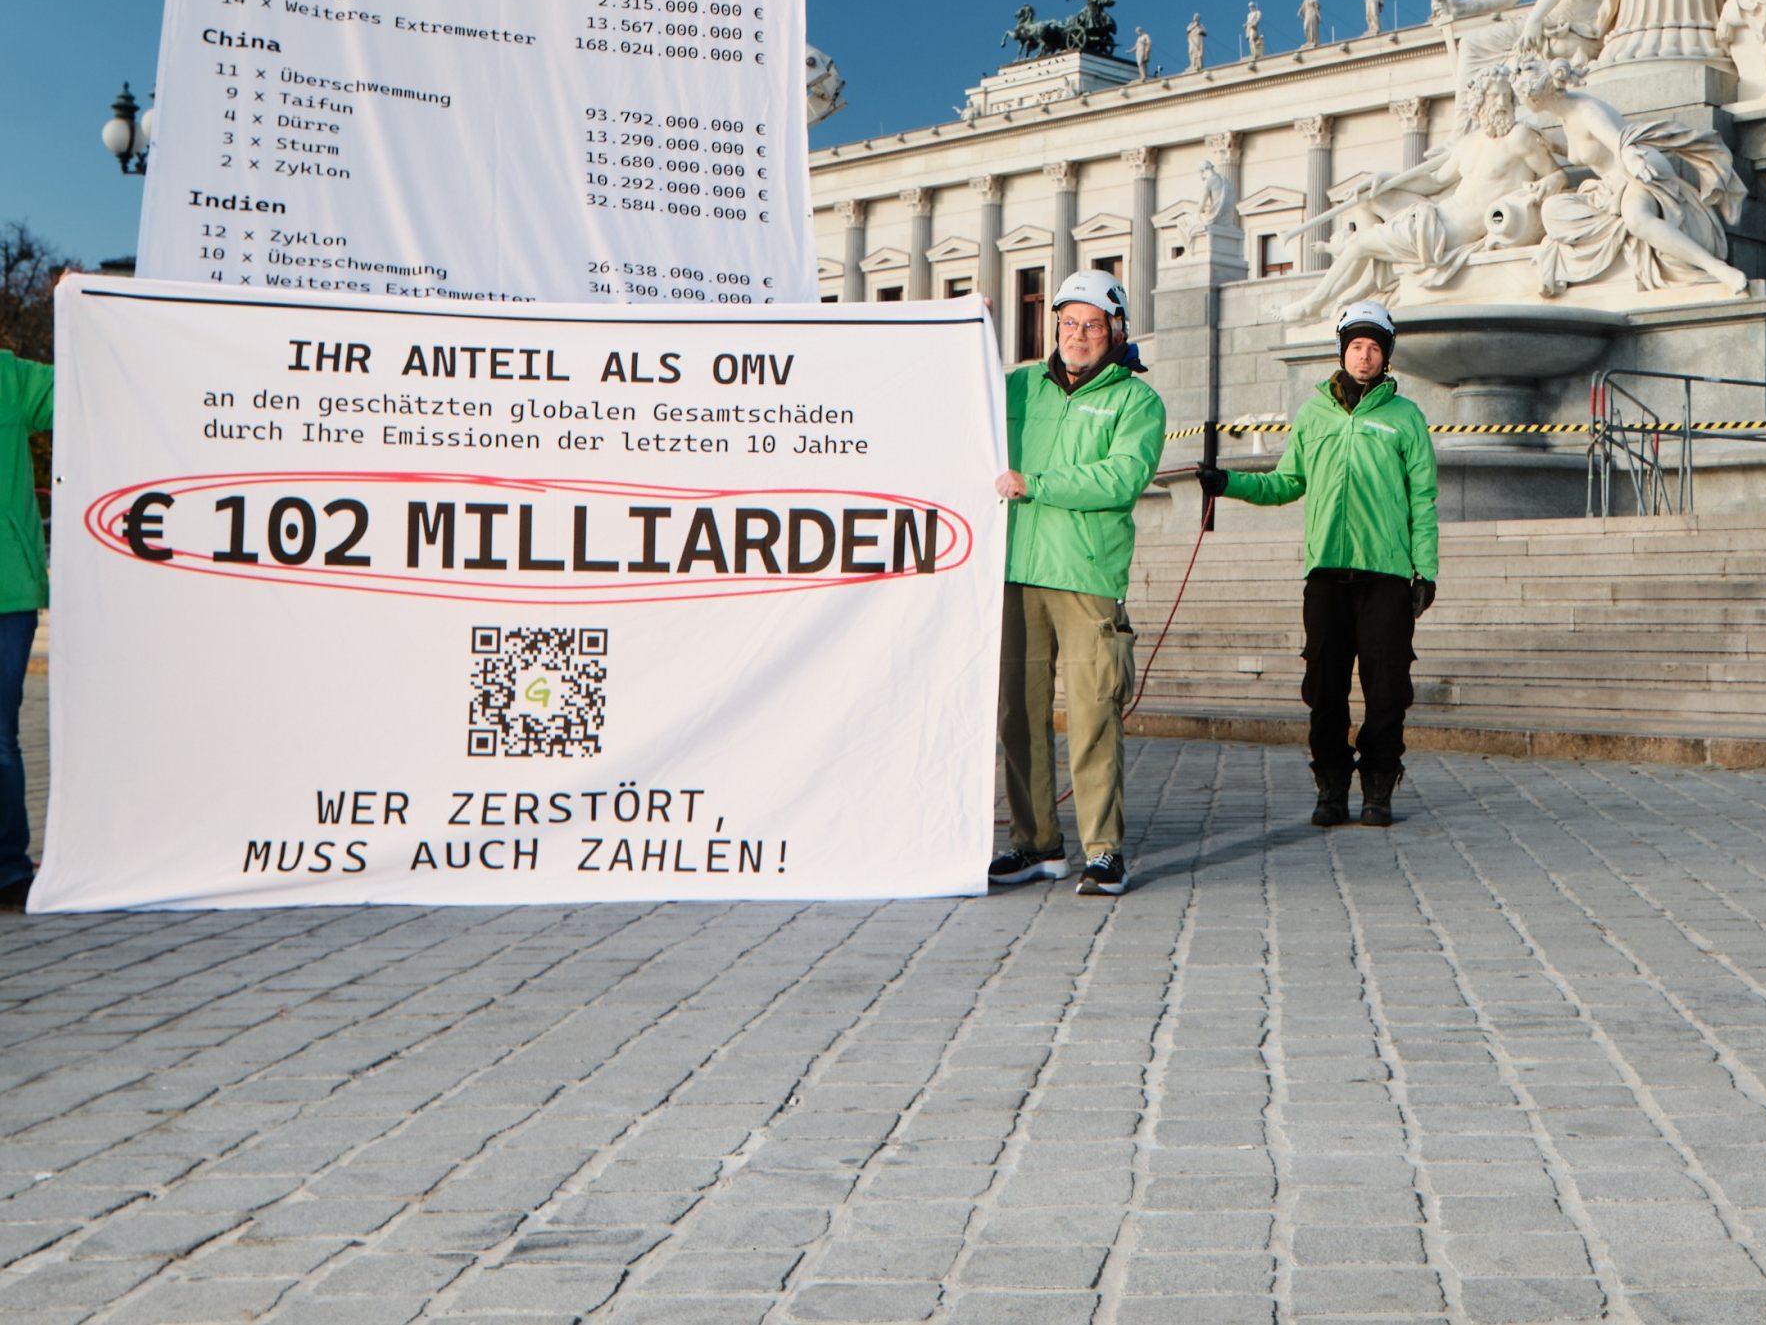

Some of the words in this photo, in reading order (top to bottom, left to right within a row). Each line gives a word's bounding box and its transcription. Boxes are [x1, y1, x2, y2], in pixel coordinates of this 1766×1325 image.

[285, 0, 381, 25] Weiteres
[395, 16, 536, 45] Extremwetter
[753, 7, 763, 20] €
[202, 28, 281, 53] China
[587, 17, 742, 40] 13.567.000.000
[754, 30, 764, 43] €
[576, 37, 743, 62] 168.024.000.000
[755, 53, 765, 65] €
[216, 62, 238, 77] 11
[281, 67, 451, 108] Überschwemmung
[226, 87, 238, 99] 9
[280, 92, 353, 115] Taifun
[224, 110, 236, 122] 4
[278, 115, 340, 134] Dürre
[586, 108, 743, 133] 93.792.000.000
[755, 124, 766, 135] €
[223, 132, 234, 144] 3
[276, 137, 339, 156] Sturm
[586, 130, 744, 155] 13.290.000.000
[756, 145, 766, 158] €
[221, 154, 232, 167] 2
[275, 160, 350, 179] Zyklon
[586, 151, 745, 177] 15.680.000.000
[757, 167, 767, 180] €
[587, 172, 745, 199] 10.292.000.000
[758, 189, 768, 201] €
[189, 190, 286, 214] Indien
[587, 193, 746, 221] 32.584.000.000
[759, 211, 769, 223] €
[202, 224, 226, 238] 12
[270, 229, 347, 247] Zyklon
[200, 247, 225, 260] 10
[268, 249, 447, 280] Überschwemmung
[588, 261, 750, 285] 26.538.000.000
[763, 277, 773, 288] €
[266, 274, 371, 294] Weiteres
[589, 281, 752, 304] 34.300.000.000
[289, 341, 370, 373] IHR
[402, 346, 569, 380] ANTEIL
[601, 352, 680, 383] ALS
[714, 354, 793, 384] OMV
[203, 392, 234, 408] an
[253, 390, 300, 410] den
[318, 393, 492, 417] geschätzten
[510, 400, 636, 423] globalen
[653, 404, 853, 424] Gesamtschäden
[203, 419, 282, 441] durch
[303, 423, 364, 444] Ihre
[383, 427, 540, 449] Emissionen
[558, 430, 604, 450] der
[622, 432, 728, 453] letzten
[747, 435, 776, 454] 10
[793, 434, 868, 454] Jahre
[123, 492, 175, 562] €
[213, 496, 371, 566] 102
[408, 502, 938, 574] MILLIARDEN
[316, 790, 409, 825] WER
[448, 781, 724, 833] ZERSTÖRT,
[243, 840, 368, 873] MUSS
[410, 838, 538, 871] AUCH
[577, 838, 787, 874] ZAHLEN!
